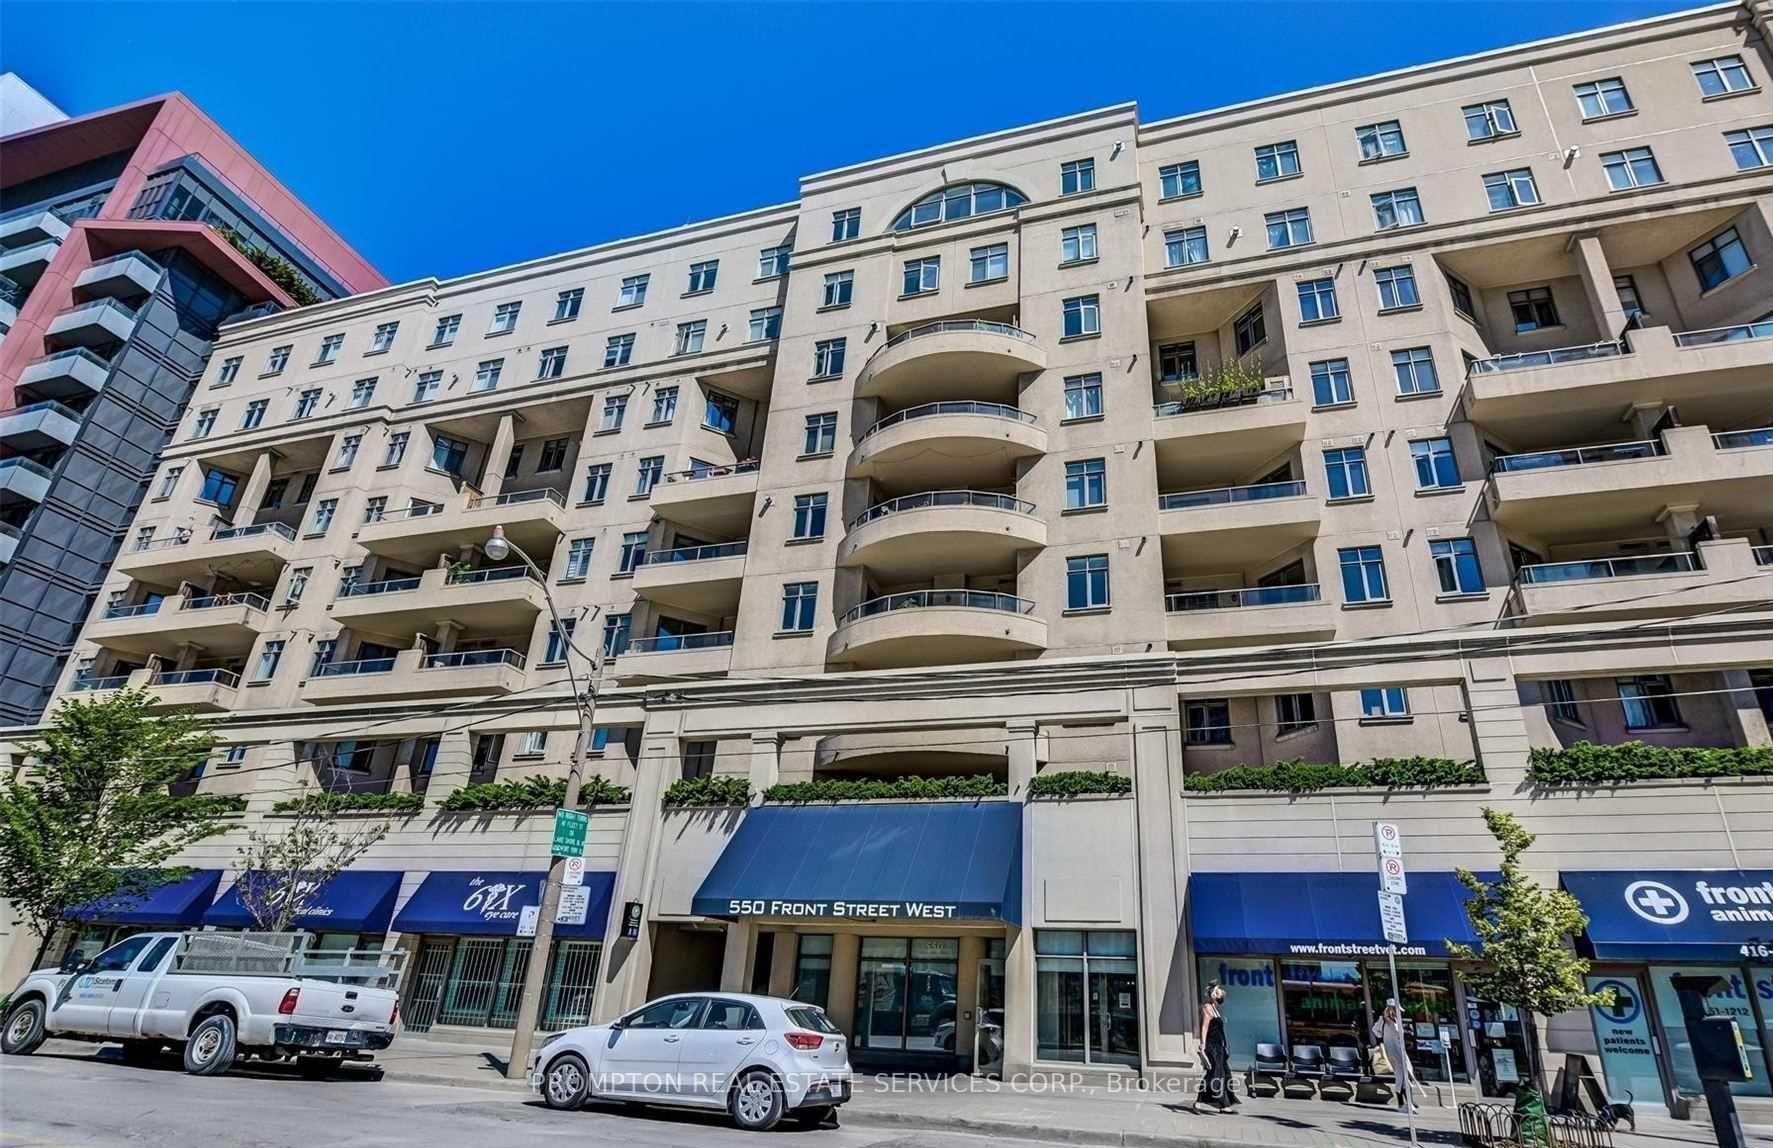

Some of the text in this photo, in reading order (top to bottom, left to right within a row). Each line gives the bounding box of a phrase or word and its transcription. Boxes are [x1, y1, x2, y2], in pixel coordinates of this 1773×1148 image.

[729, 900, 765, 915] 550
[499, 911, 520, 919] care
[1218, 962, 1274, 987] front
[1603, 1037, 1647, 1045] patients
[1604, 1046, 1650, 1055] welcome
